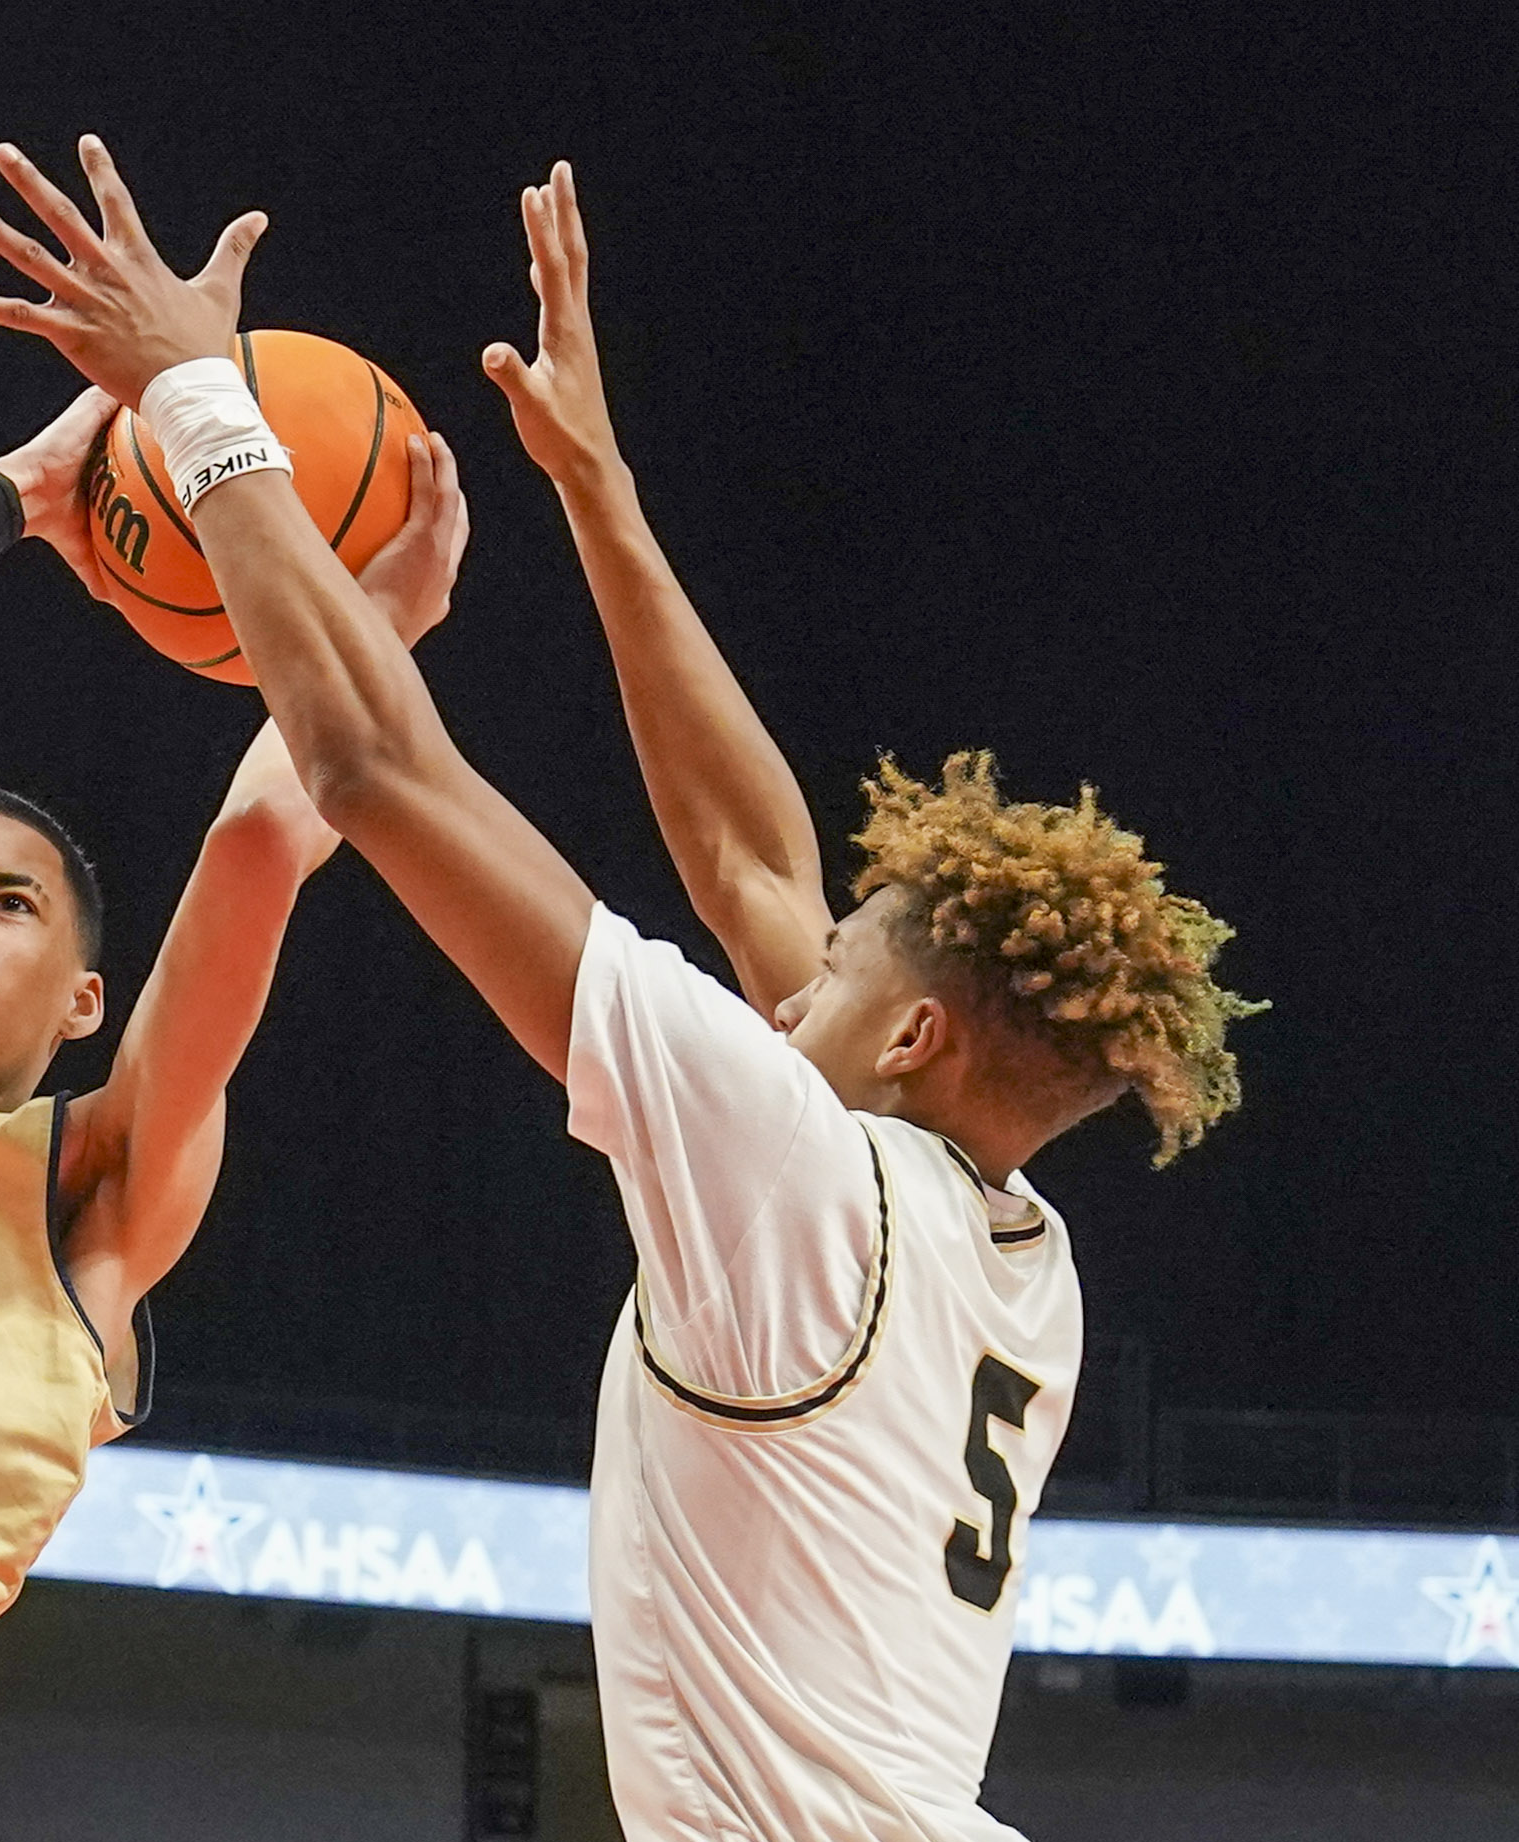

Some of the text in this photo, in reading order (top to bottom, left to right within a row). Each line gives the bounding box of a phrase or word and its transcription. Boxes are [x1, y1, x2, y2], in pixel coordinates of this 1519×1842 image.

[194, 448, 268, 494] NIKE
[944, 1352, 1042, 1613] 5
[247, 1518, 506, 1612] AHSAA
[1013, 1573, 1215, 1657] HSAA
